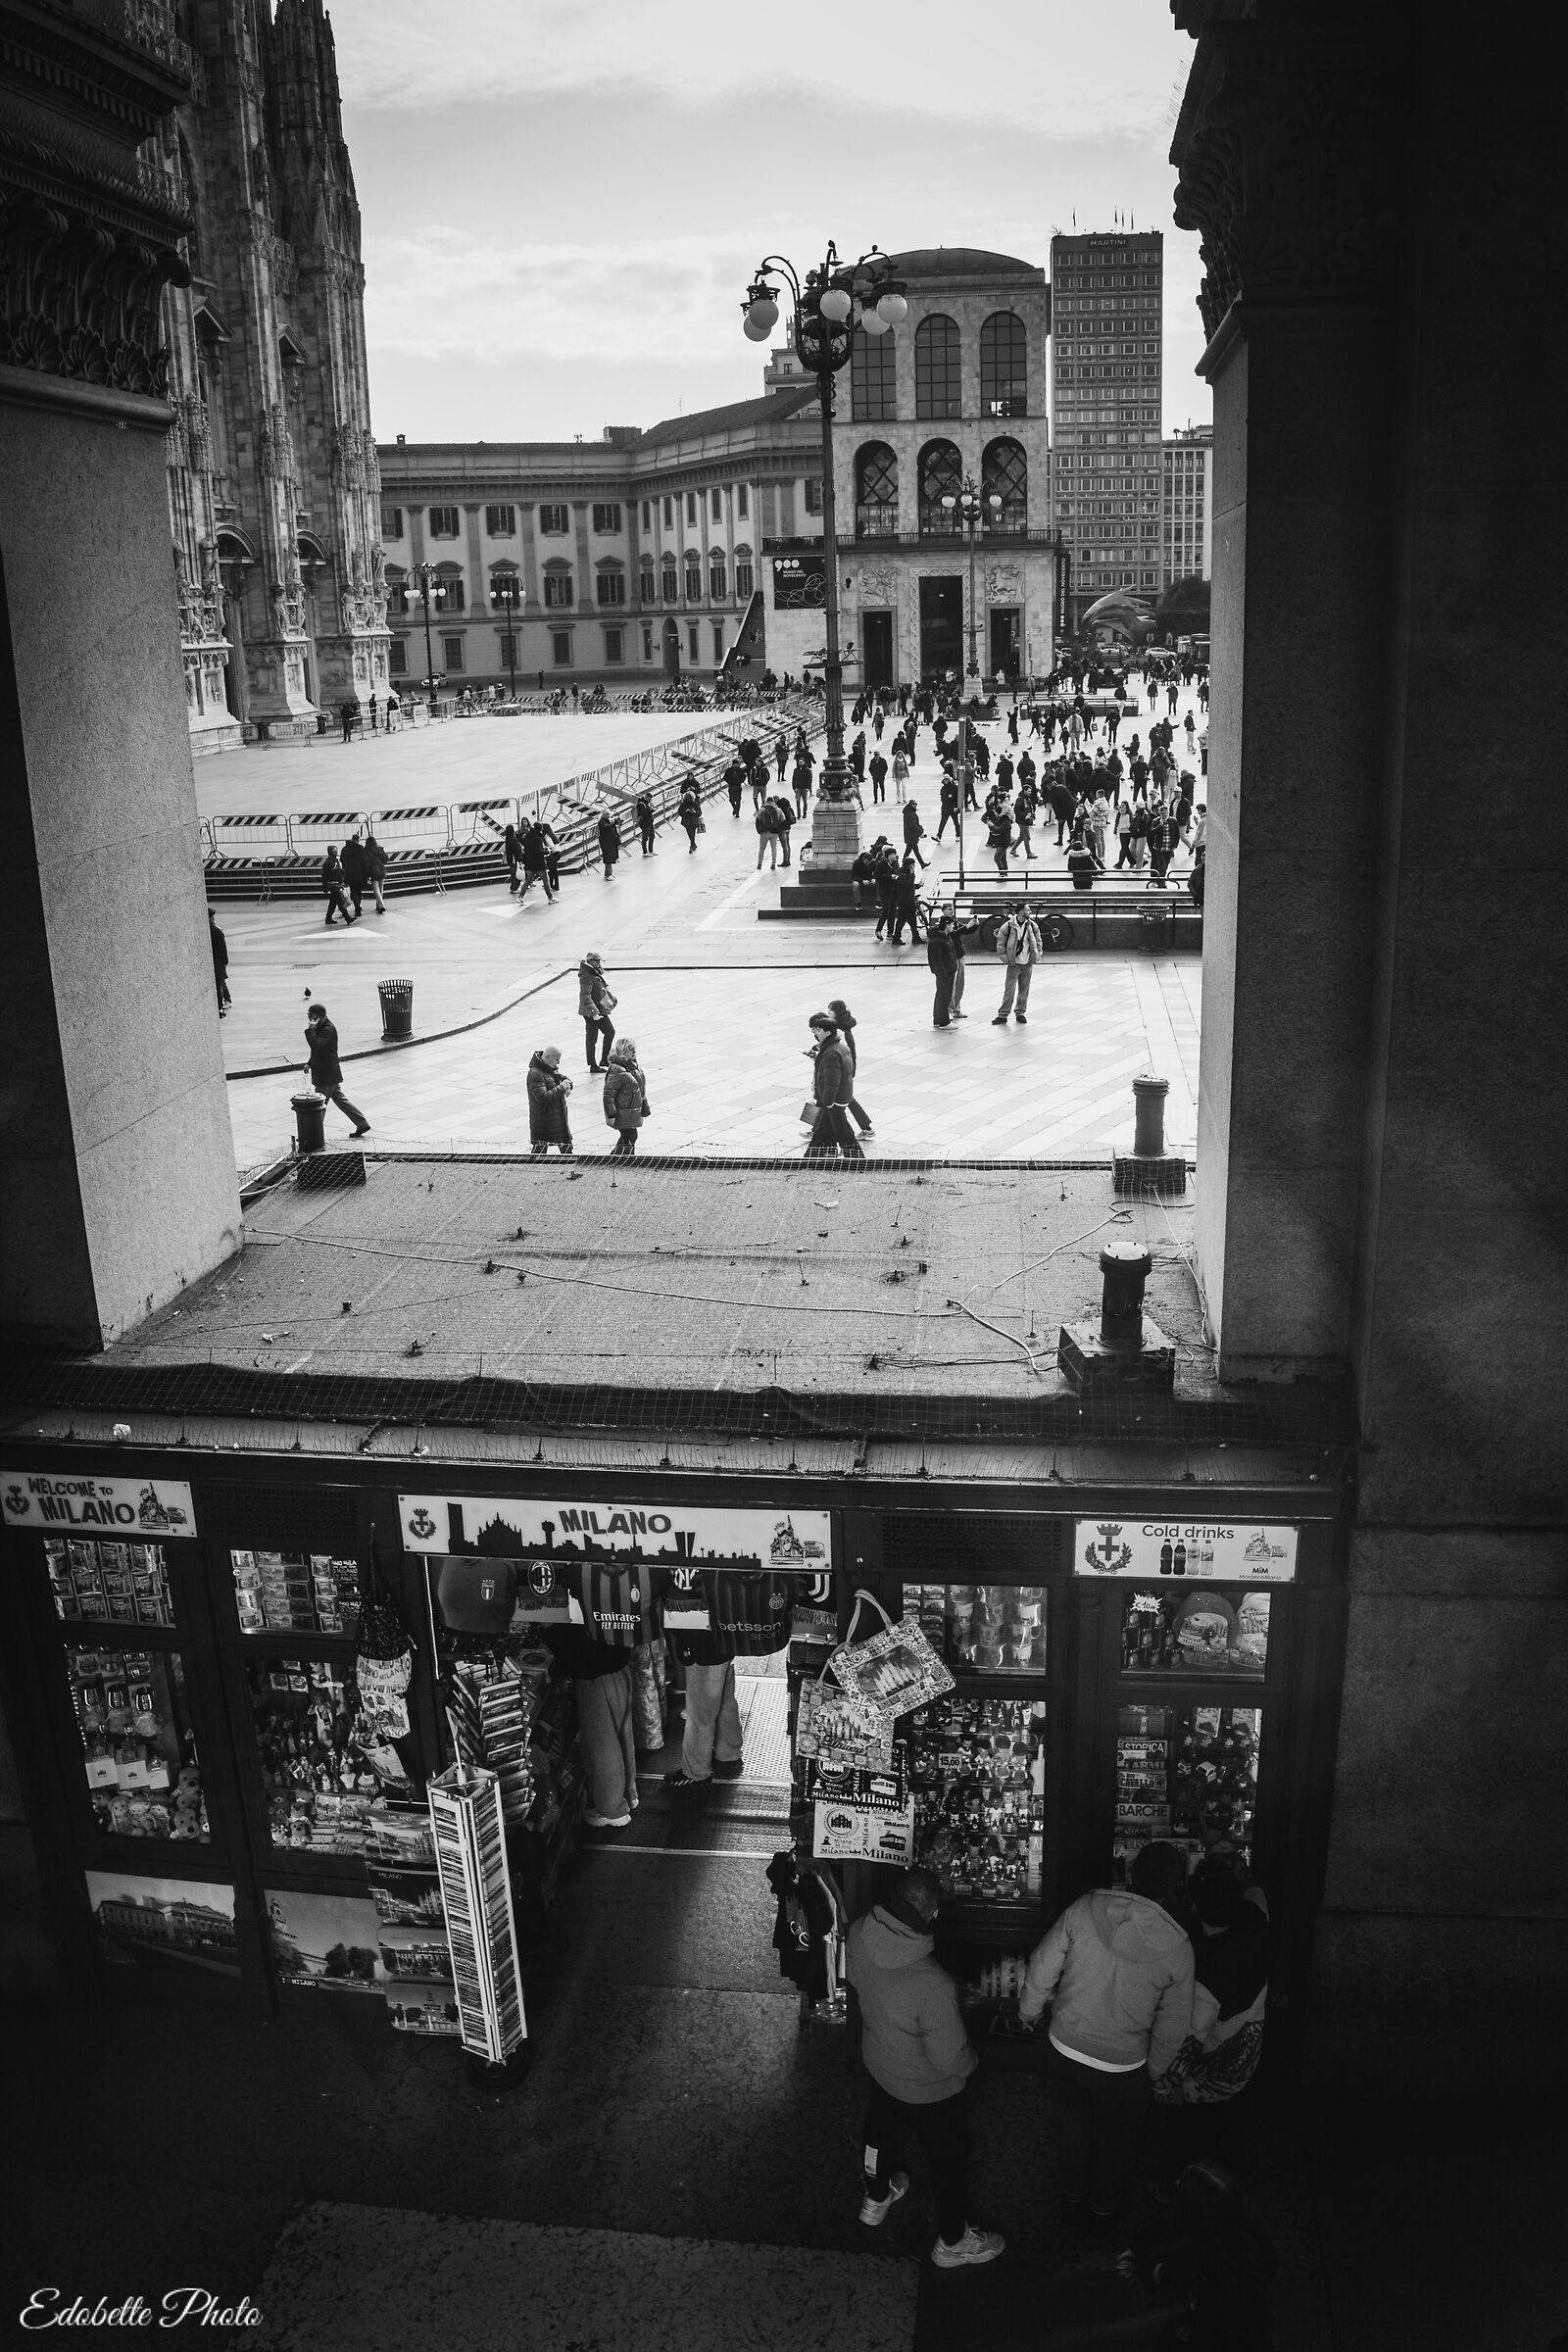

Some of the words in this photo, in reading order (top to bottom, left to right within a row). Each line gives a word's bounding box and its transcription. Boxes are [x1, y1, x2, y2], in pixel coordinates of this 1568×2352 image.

[27, 1478, 96, 1496] WELCOME
[99, 1487, 113, 1495] TO
[38, 1495, 135, 1525] MILANO
[559, 1509, 671, 1534] MILANO
[1142, 1525, 1179, 1538] Cold
[1185, 1526, 1235, 1540] drinks
[592, 1611, 641, 1623] Emirates
[612, 1622, 635, 1631] BETTER
[717, 1618, 781, 1632] betsson
[940, 1755, 959, 1767] 15,00
[852, 1792, 901, 1807] Milano
[1118, 1805, 1168, 1818] BARCHE
[861, 1847, 908, 1864] Milano
